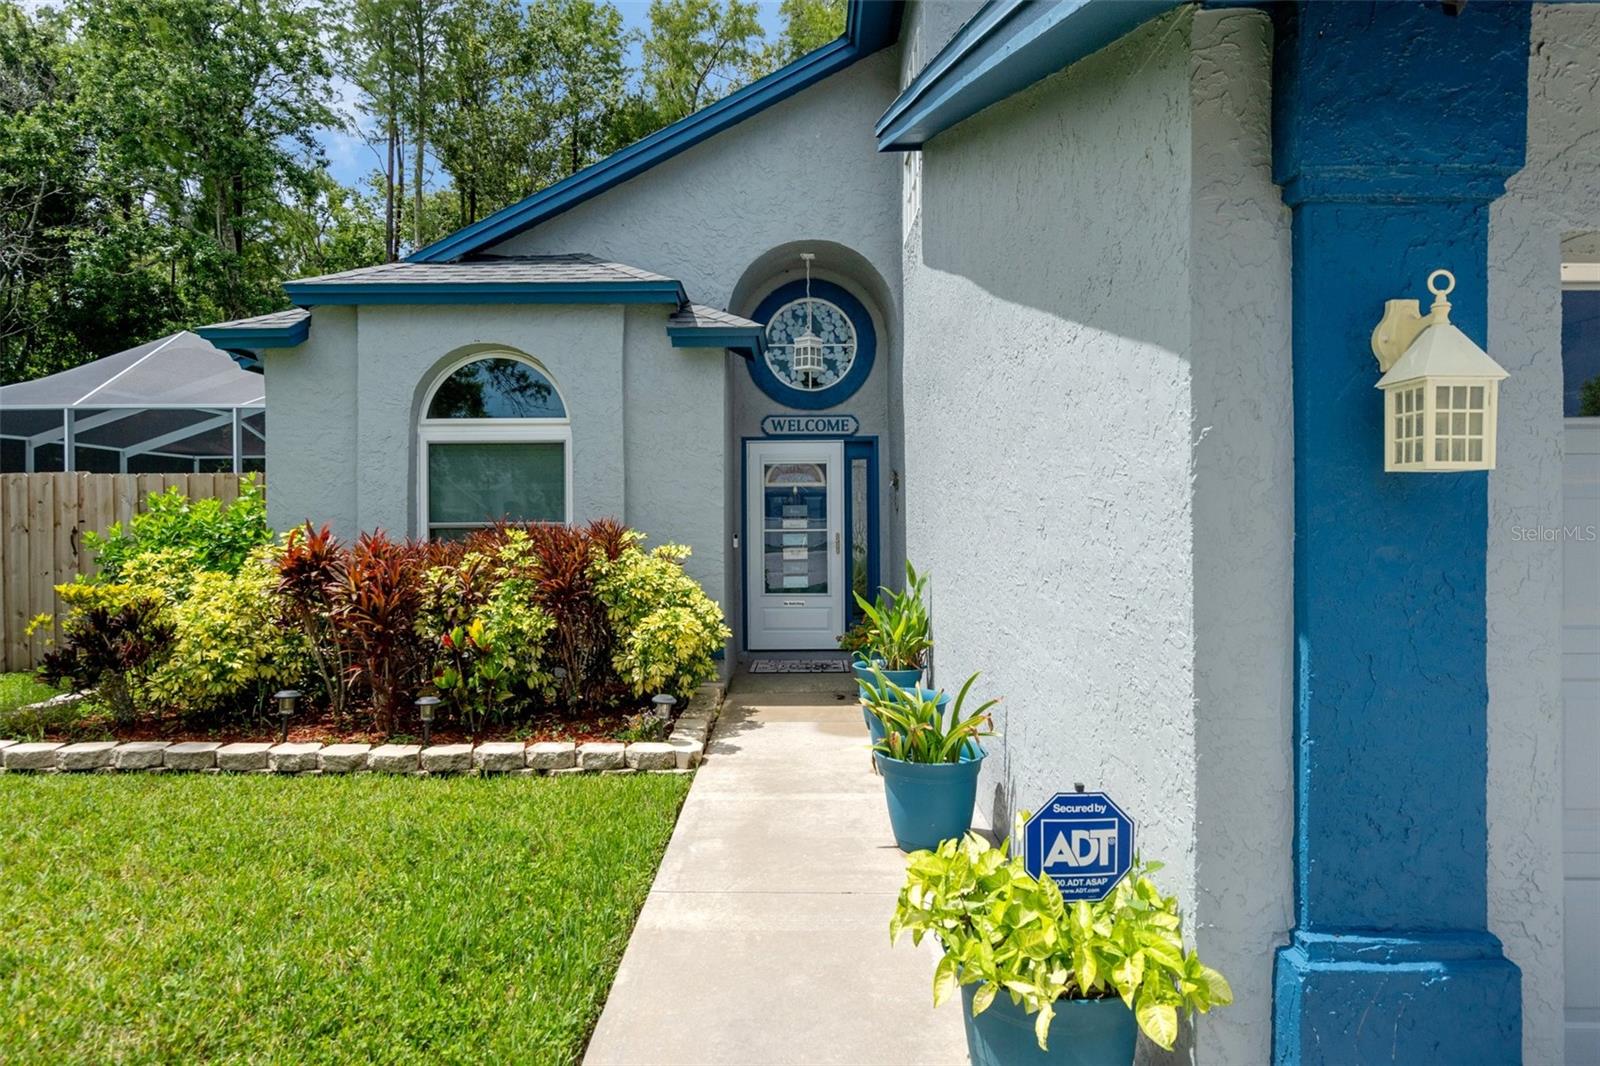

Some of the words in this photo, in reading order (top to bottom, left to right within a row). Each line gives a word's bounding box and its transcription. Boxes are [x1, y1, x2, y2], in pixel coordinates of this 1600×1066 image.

[771, 419, 849, 432] WELCOME
[1053, 803, 1095, 813] Secured
[1095, 803, 1107, 814] by
[1043, 829, 1116, 867] ADT
